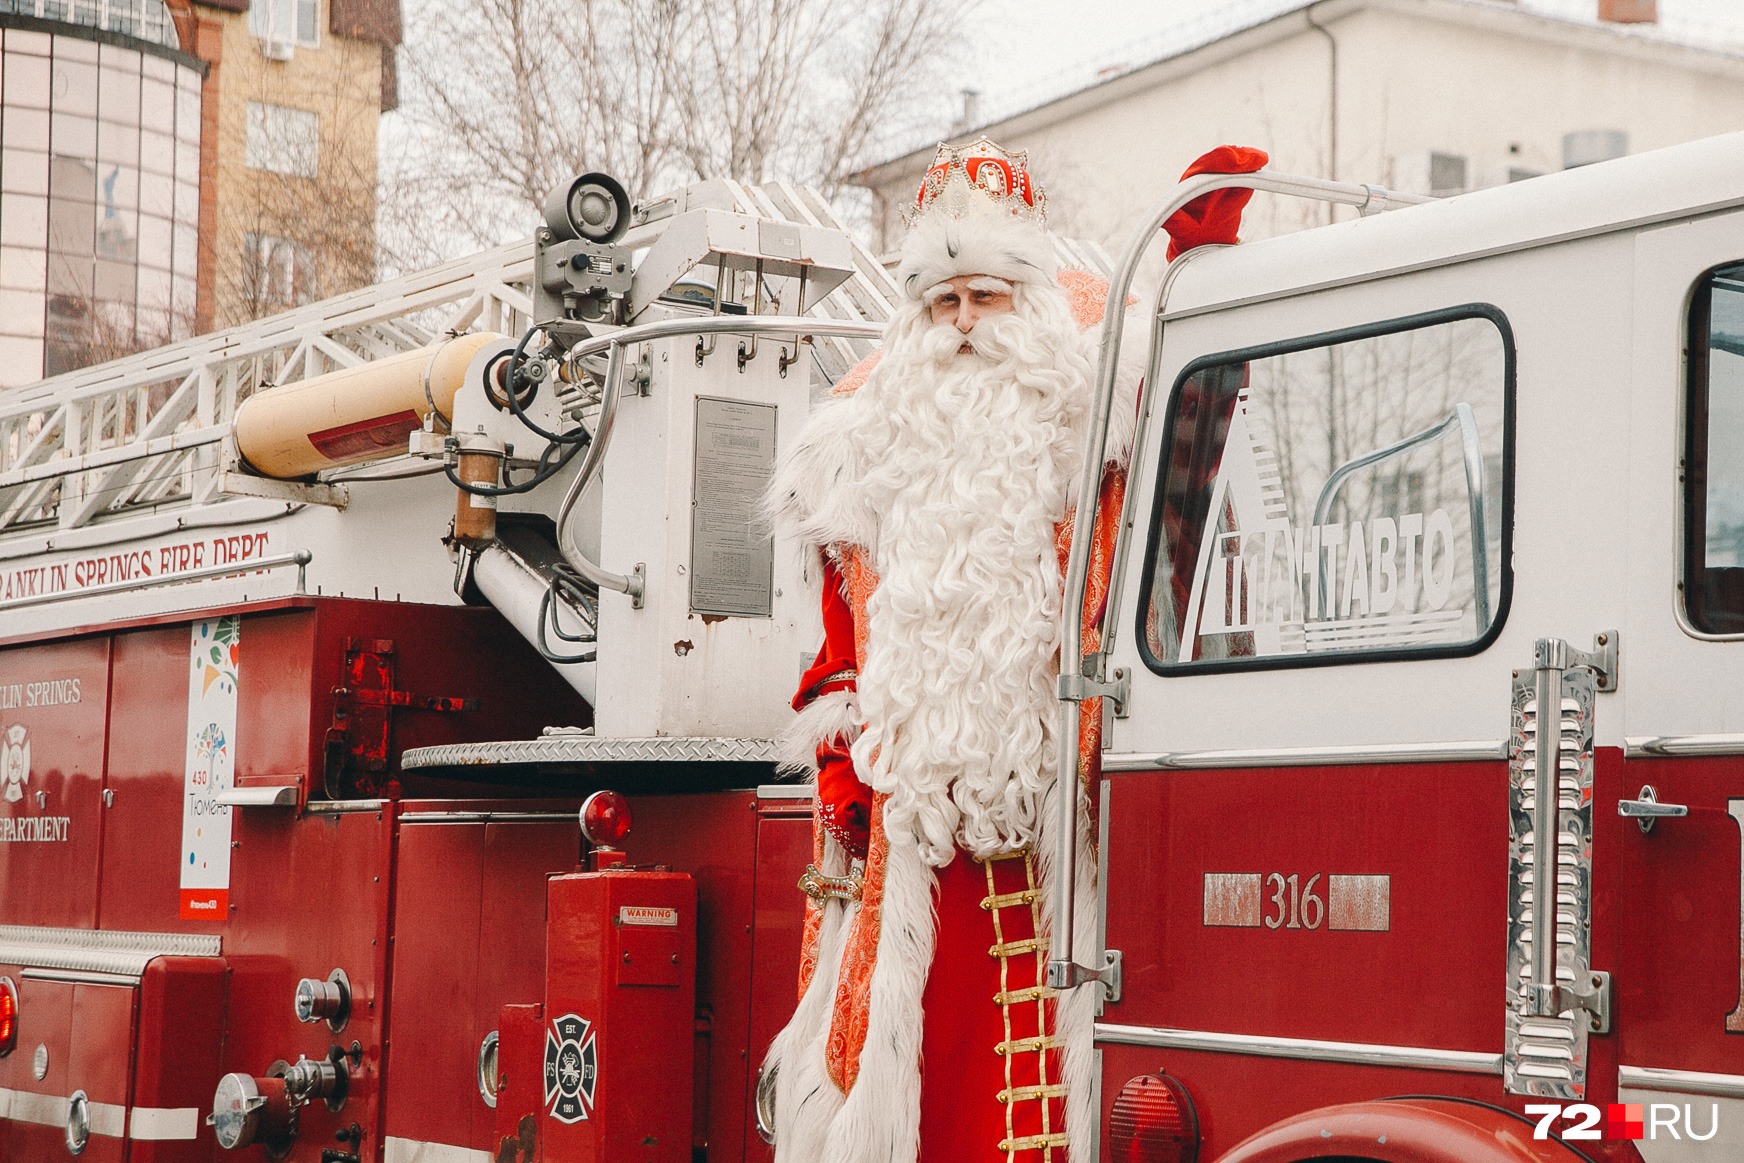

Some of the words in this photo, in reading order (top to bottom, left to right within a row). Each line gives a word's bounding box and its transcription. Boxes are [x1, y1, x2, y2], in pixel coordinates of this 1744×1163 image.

[0, 563, 69, 600] ANKLIN
[75, 550, 152, 589] SPRINGS
[160, 541, 205, 584] FIRE
[0, 683, 23, 709] LIN
[26, 678, 81, 707] SPRINGS
[192, 770, 207, 785] 430
[1264, 872, 1325, 931] 316
[626, 909, 672, 918] WARNING
[584, 1064, 594, 1079] FD
[563, 1104, 574, 1114] 1961
